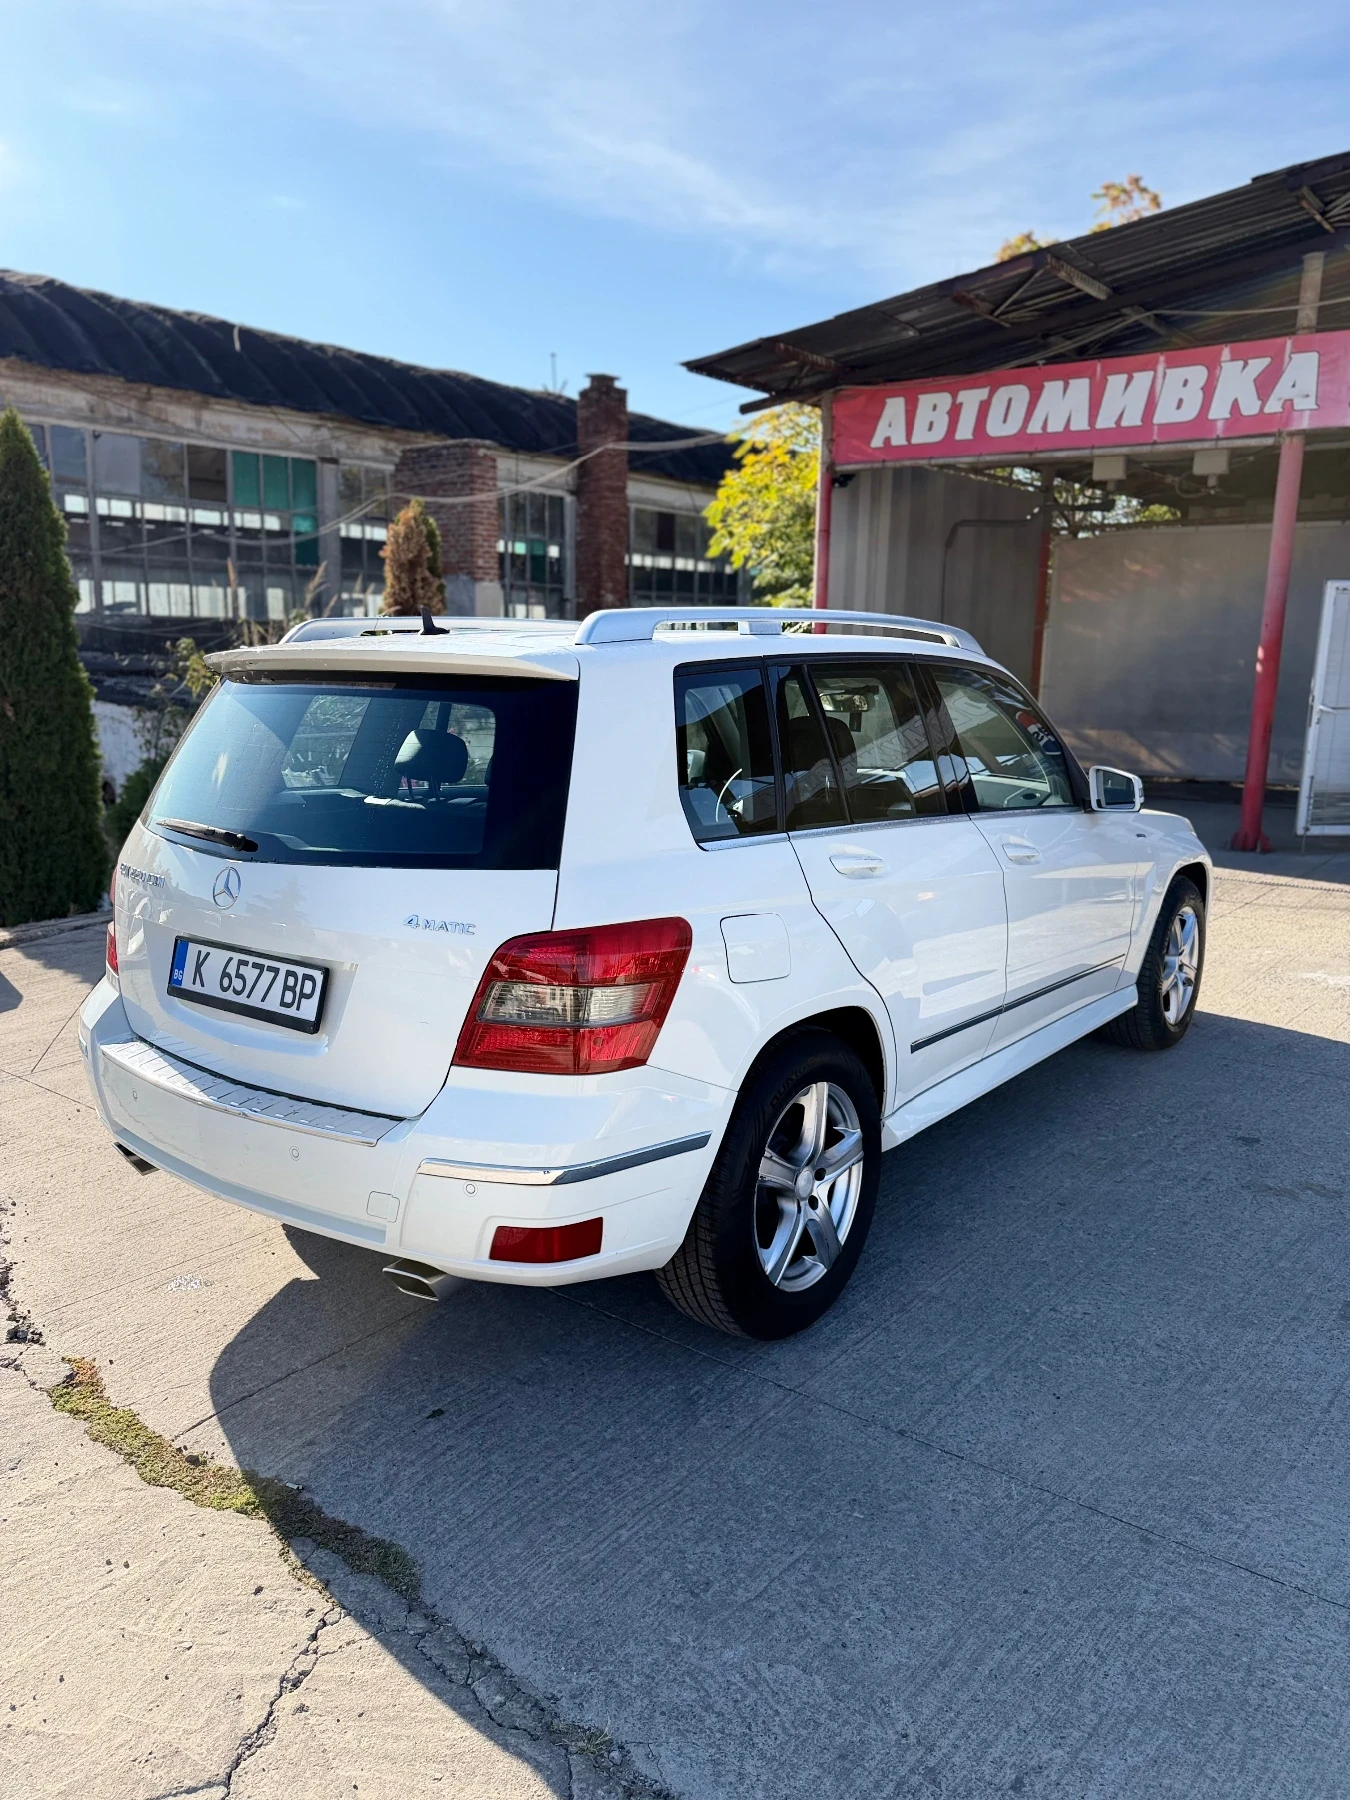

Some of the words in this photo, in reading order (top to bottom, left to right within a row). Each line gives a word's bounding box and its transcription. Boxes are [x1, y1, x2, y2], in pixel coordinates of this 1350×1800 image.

[869, 350, 1320, 449] АВТОМИВКА
[192, 950, 211, 988] K
[219, 956, 281, 1003] 6577
[279, 969, 317, 1012] BP
